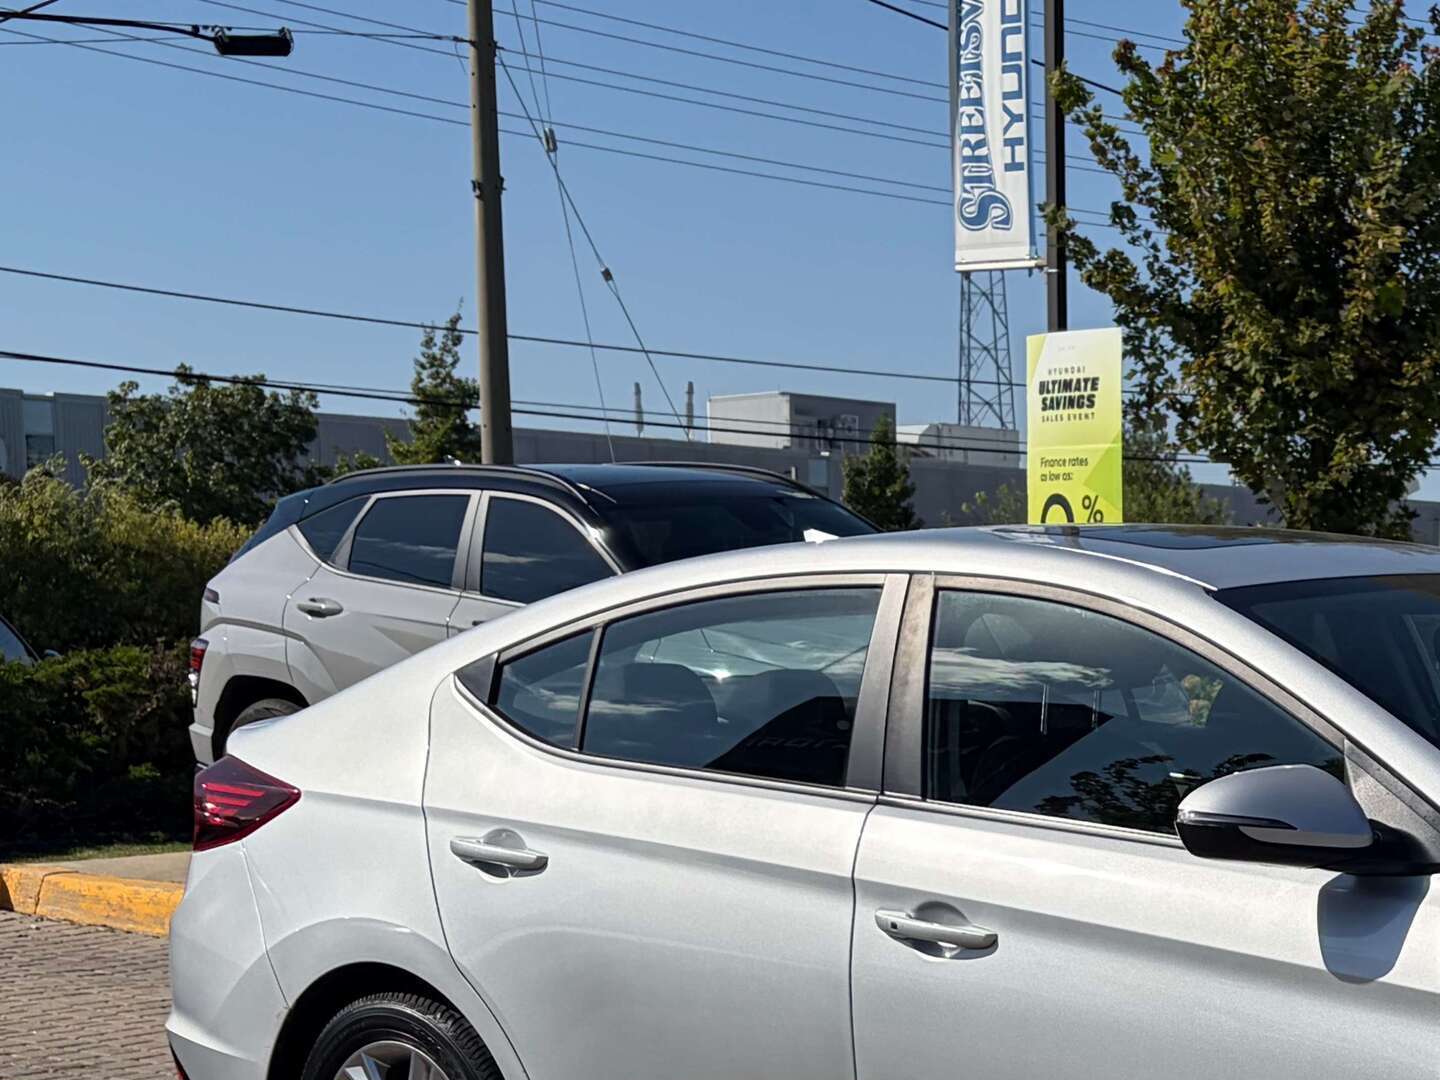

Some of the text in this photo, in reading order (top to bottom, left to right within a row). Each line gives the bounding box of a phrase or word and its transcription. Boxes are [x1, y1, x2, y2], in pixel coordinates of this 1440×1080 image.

[1048, 366, 1086, 376] HYUNDAI
[1039, 377, 1100, 395] ULTIMATE
[1041, 394, 1096, 412] SAVINGS
[1041, 412, 1095, 423] SALES EVENT
[1040, 456, 1089, 468] Finance rates
[1049, 471, 1060, 481] low
